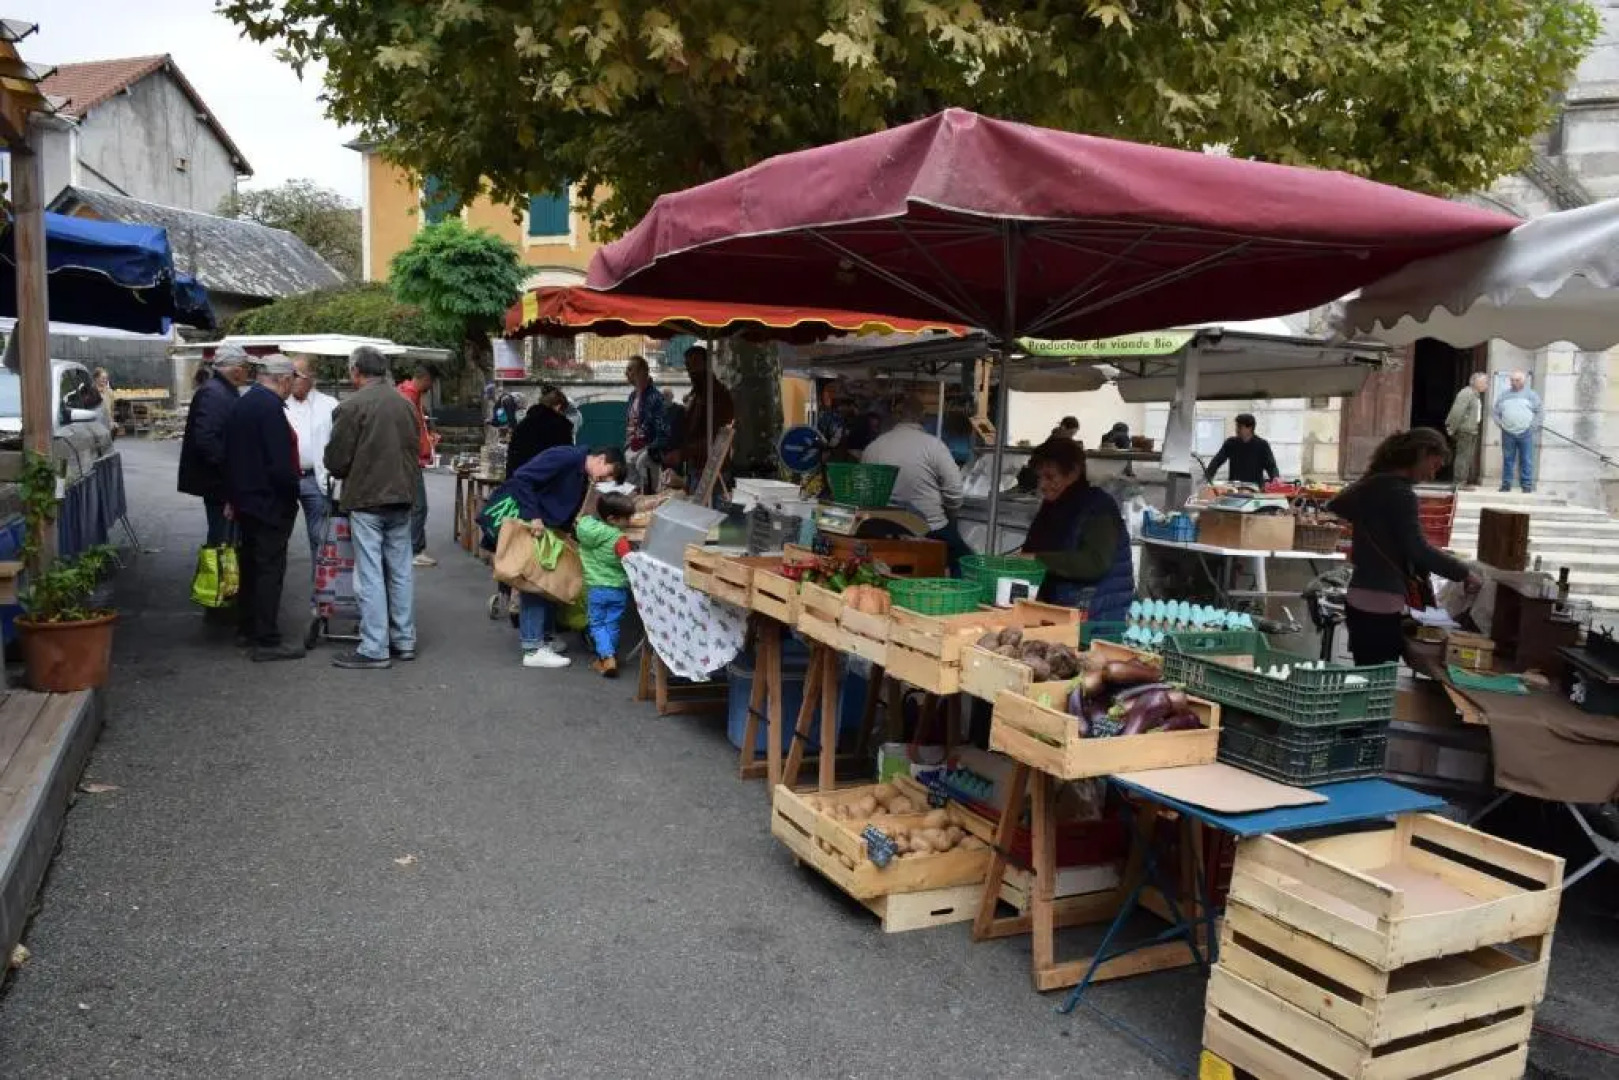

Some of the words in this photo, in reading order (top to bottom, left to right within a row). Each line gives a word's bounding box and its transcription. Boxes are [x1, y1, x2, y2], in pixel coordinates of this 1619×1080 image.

[1028, 340, 1088, 350] Producteur
[1092, 339, 1106, 349] de
[1111, 337, 1151, 348] viande
[1154, 337, 1172, 348] Bio
